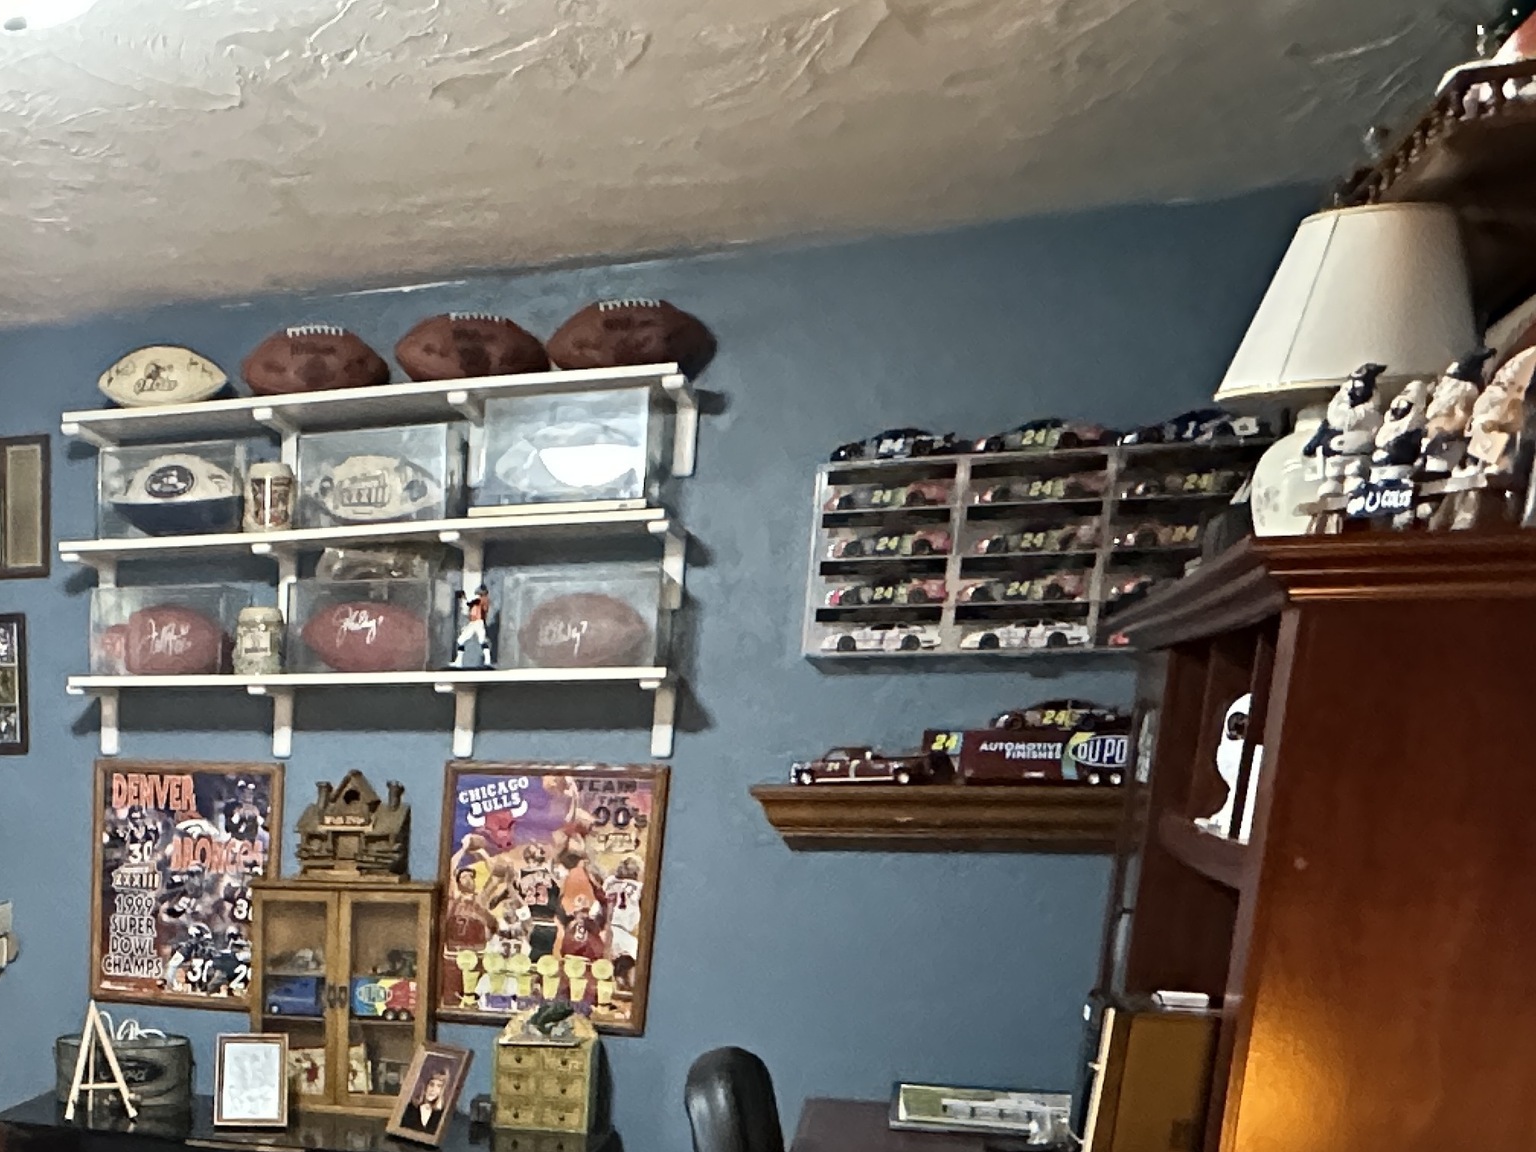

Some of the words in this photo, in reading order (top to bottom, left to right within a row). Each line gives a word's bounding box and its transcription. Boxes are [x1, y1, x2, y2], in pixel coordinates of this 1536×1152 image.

[1022, 428, 1047, 446] 24
[1029, 480, 1053, 497] 24
[875, 536, 900, 551] 24
[1021, 532, 1046, 548] 24
[873, 586, 894, 600] 24
[1007, 581, 1030, 596] 24
[1042, 710, 1066, 726] 24
[931, 734, 959, 751] 24
[979, 741, 1063, 753] AUTOMOTIVE
[1005, 750, 1062, 760] FINISHES
[112, 773, 197, 811] DENVER
[458, 776, 529, 804] CHICAGO
[575, 779, 637, 793] TEAM
[470, 792, 522, 816] BULLS
[113, 872, 160, 888] XXXIII
[115, 894, 155, 914] 1999
[111, 915, 156, 935] SUPER
[102, 956, 163, 977] CHAMPS
